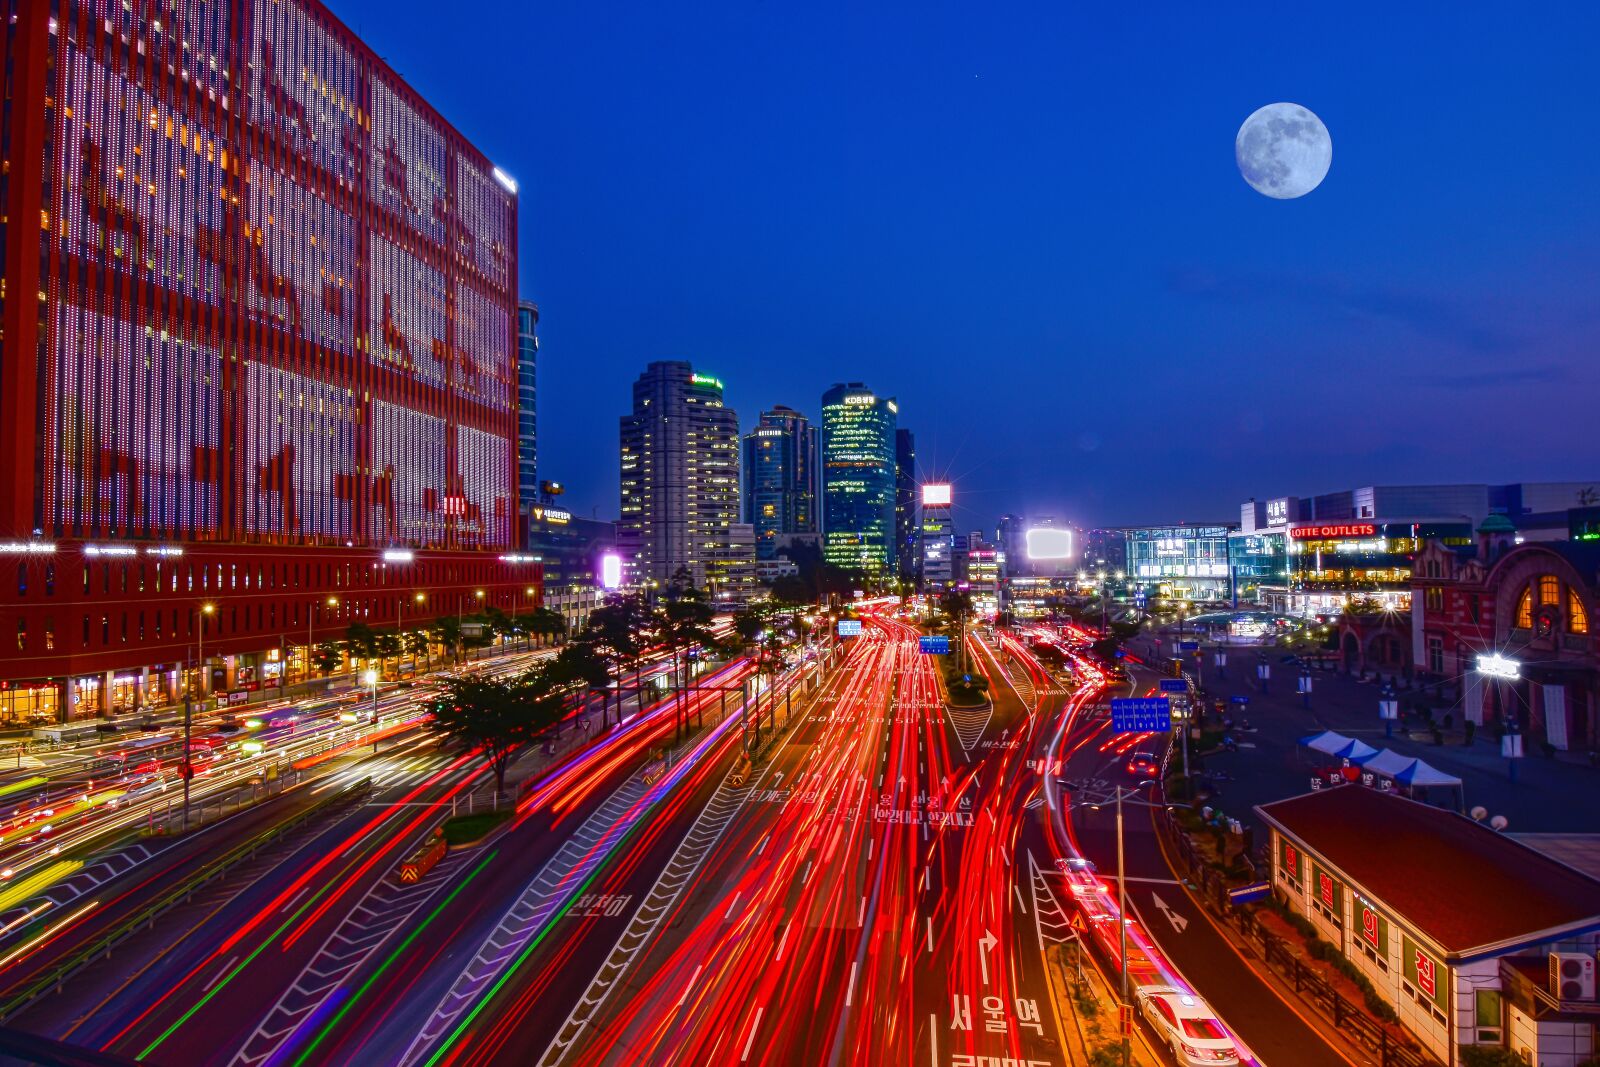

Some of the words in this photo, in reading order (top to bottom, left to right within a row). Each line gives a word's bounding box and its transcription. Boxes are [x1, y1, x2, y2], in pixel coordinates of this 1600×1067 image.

[1292, 527, 1318, 537] LOTTE
[1321, 525, 1374, 536] OUTLETS
[950, 993, 1044, 1036] 서울역
